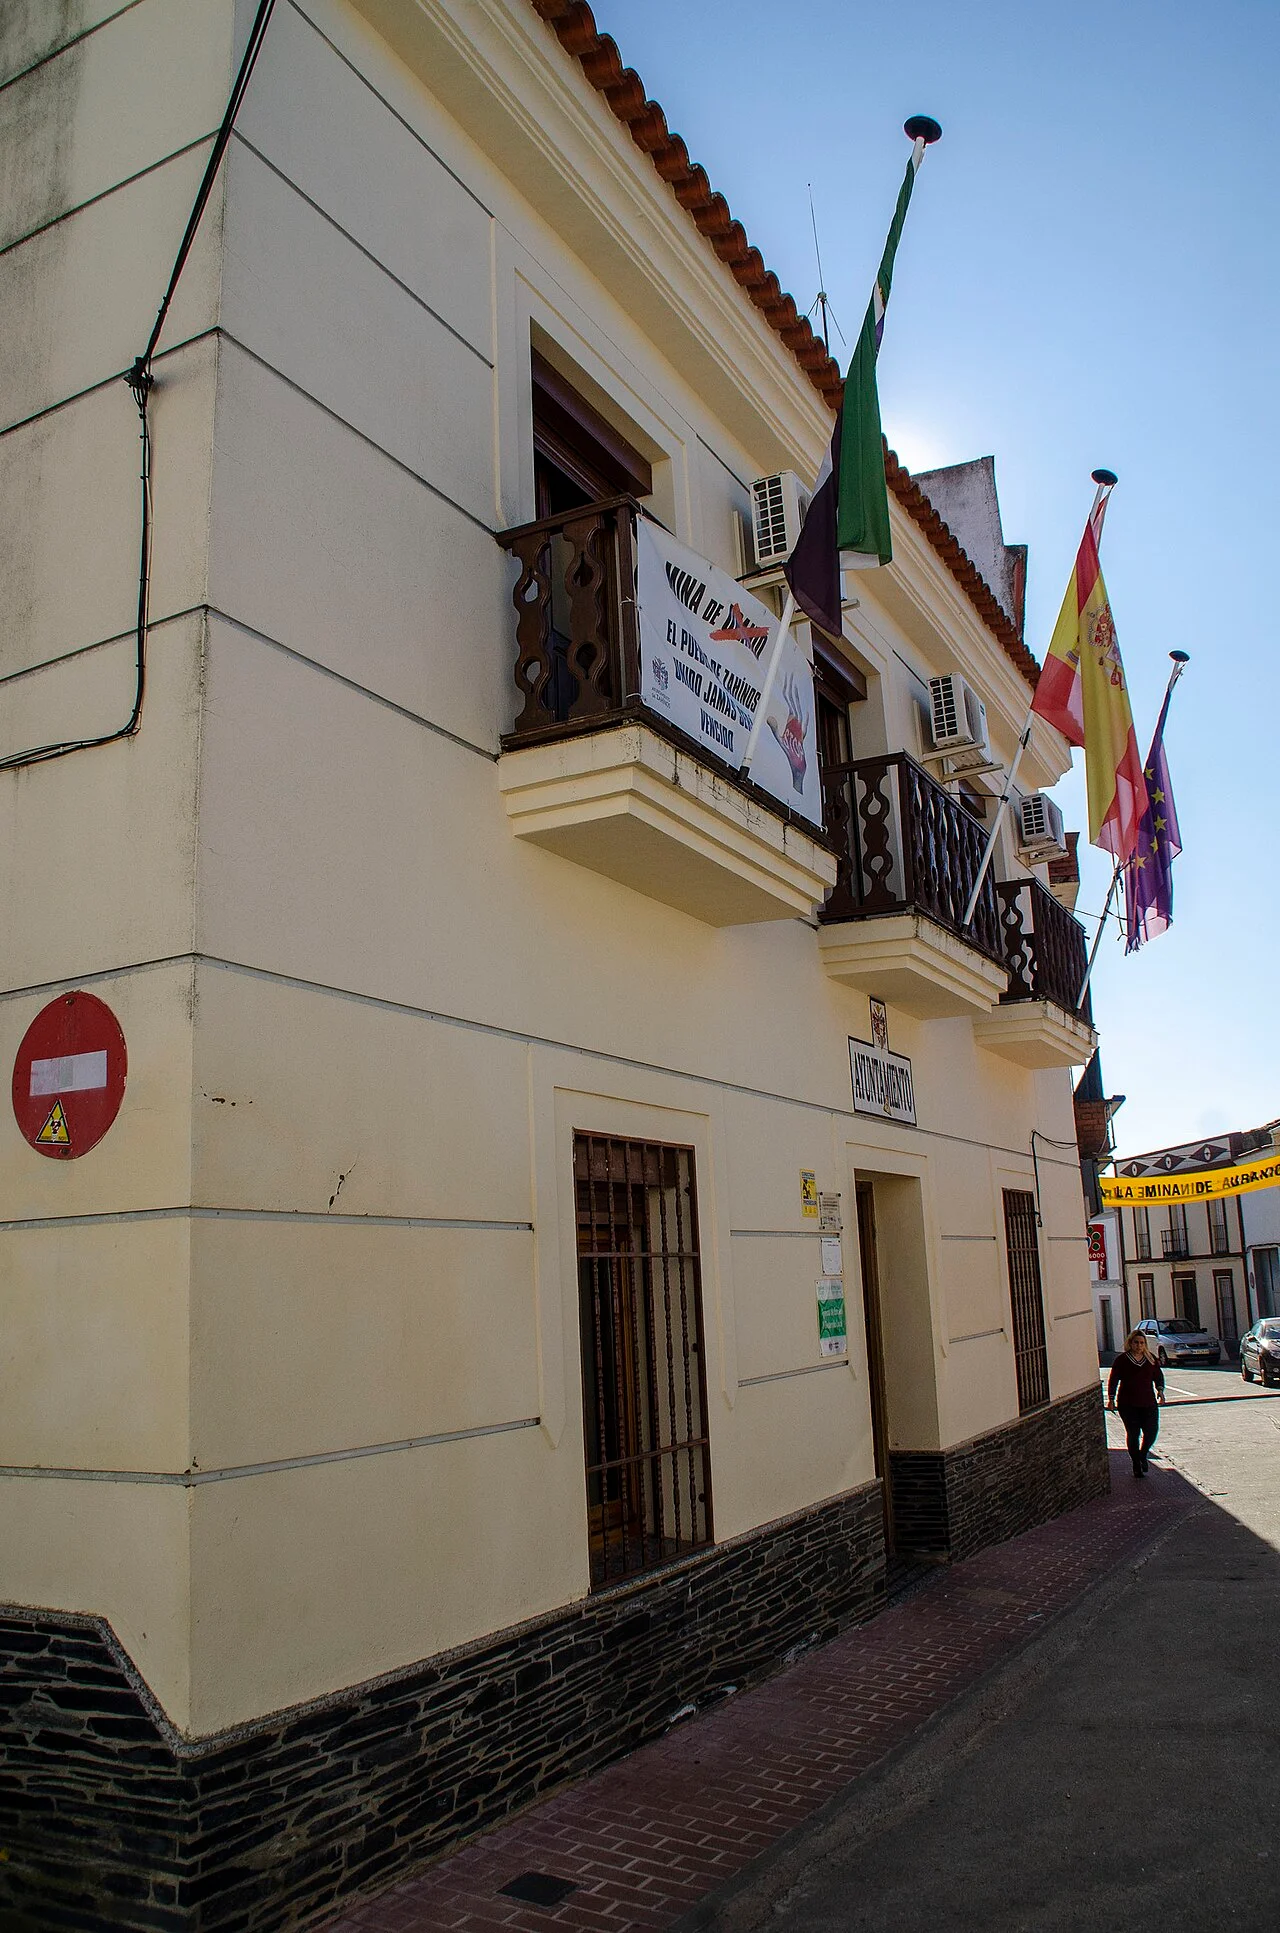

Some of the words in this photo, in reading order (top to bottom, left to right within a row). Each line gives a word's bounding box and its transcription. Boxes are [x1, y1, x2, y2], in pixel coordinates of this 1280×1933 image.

[665, 560, 706, 615] MINA
[702, 598, 724, 626] DE
[667, 618, 677, 646] EL
[673, 657, 703, 698] UNIDO
[700, 708, 734, 753] VENCIDO
[854, 1051, 912, 1112] AYUNTAMIENTO
[1116, 1186, 1134, 1198] LA
[1145, 1183, 1181, 1198] MINA
[1195, 1180, 1214, 1194] DE
